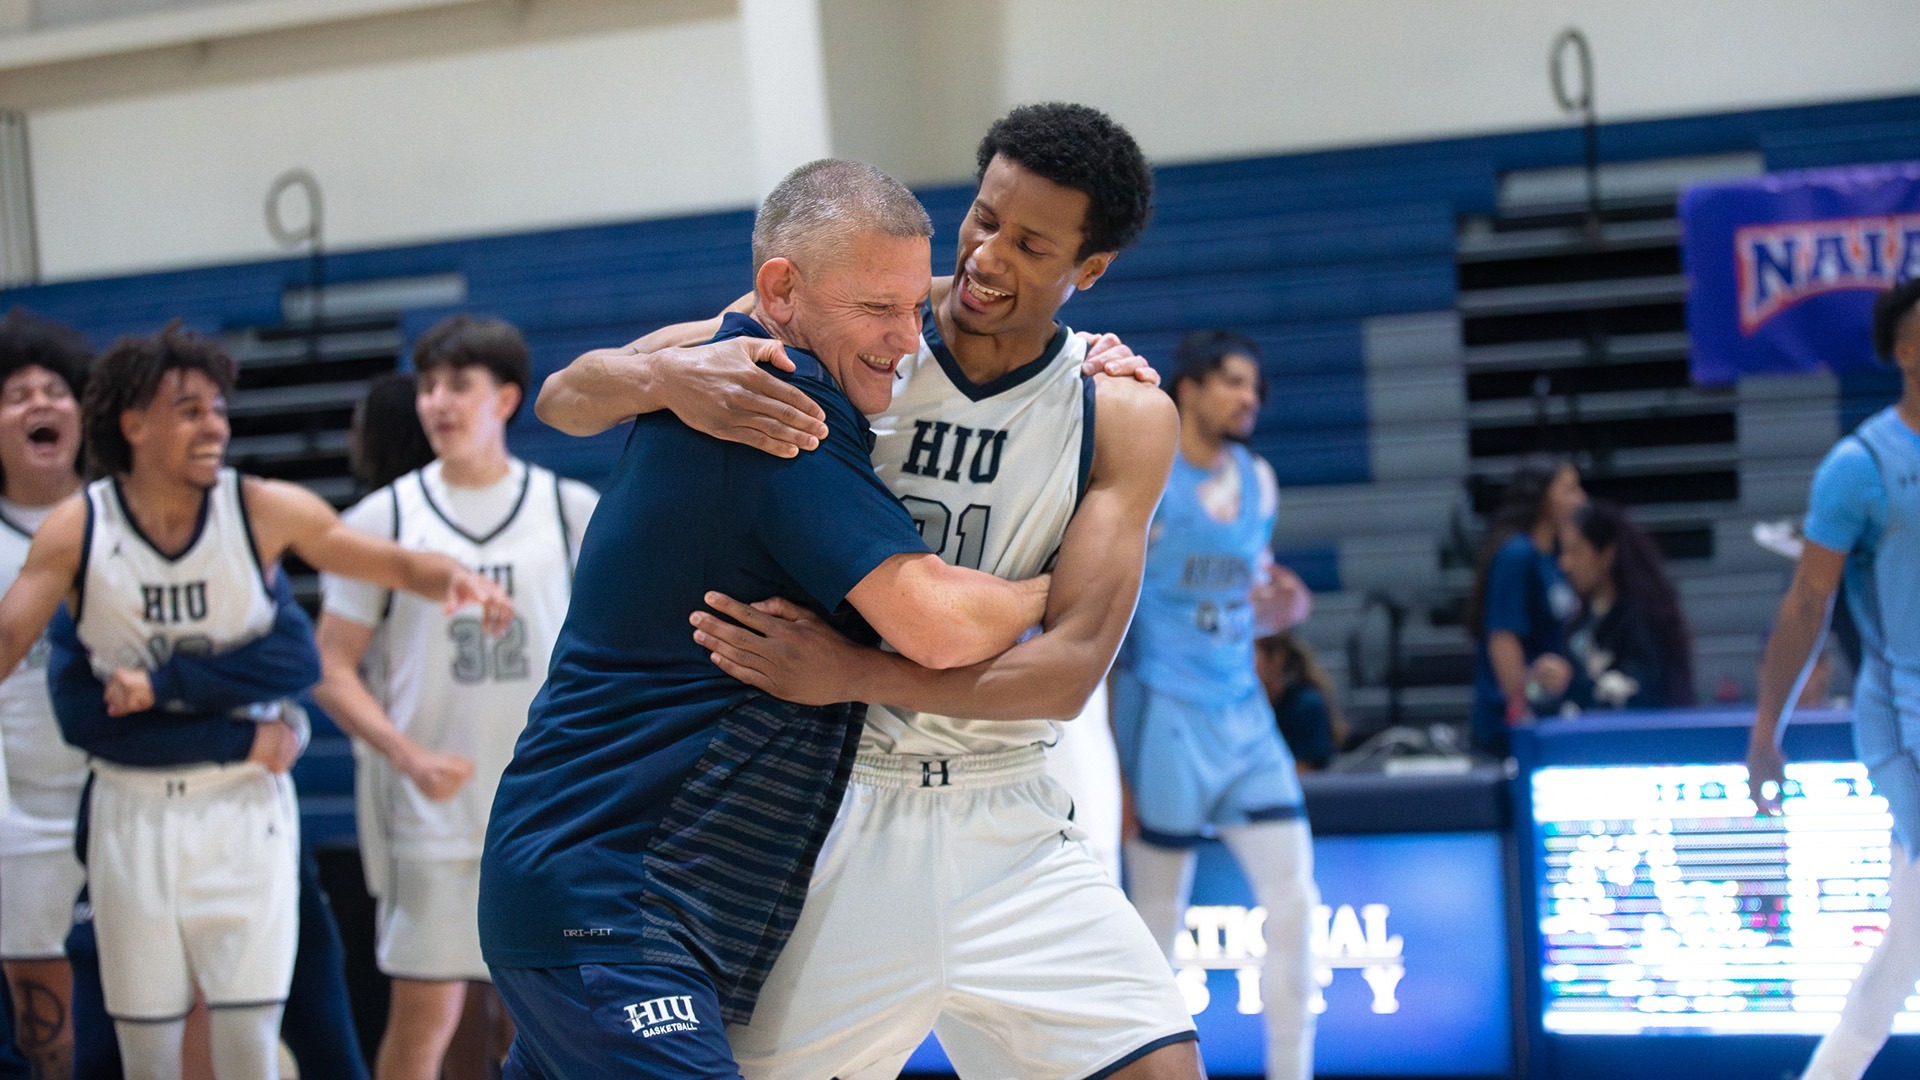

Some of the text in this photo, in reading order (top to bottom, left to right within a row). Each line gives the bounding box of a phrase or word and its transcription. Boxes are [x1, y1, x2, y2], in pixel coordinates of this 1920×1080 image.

[902, 419, 1008, 484] HIU
[141, 580, 208, 623] HIU
[449, 616, 530, 684] 32
[919, 759, 952, 788] H
[563, 928, 613, 937] DRI-FIT
[624, 995, 700, 1034] HIU
[642, 1022, 698, 1038] BASKETBALL
